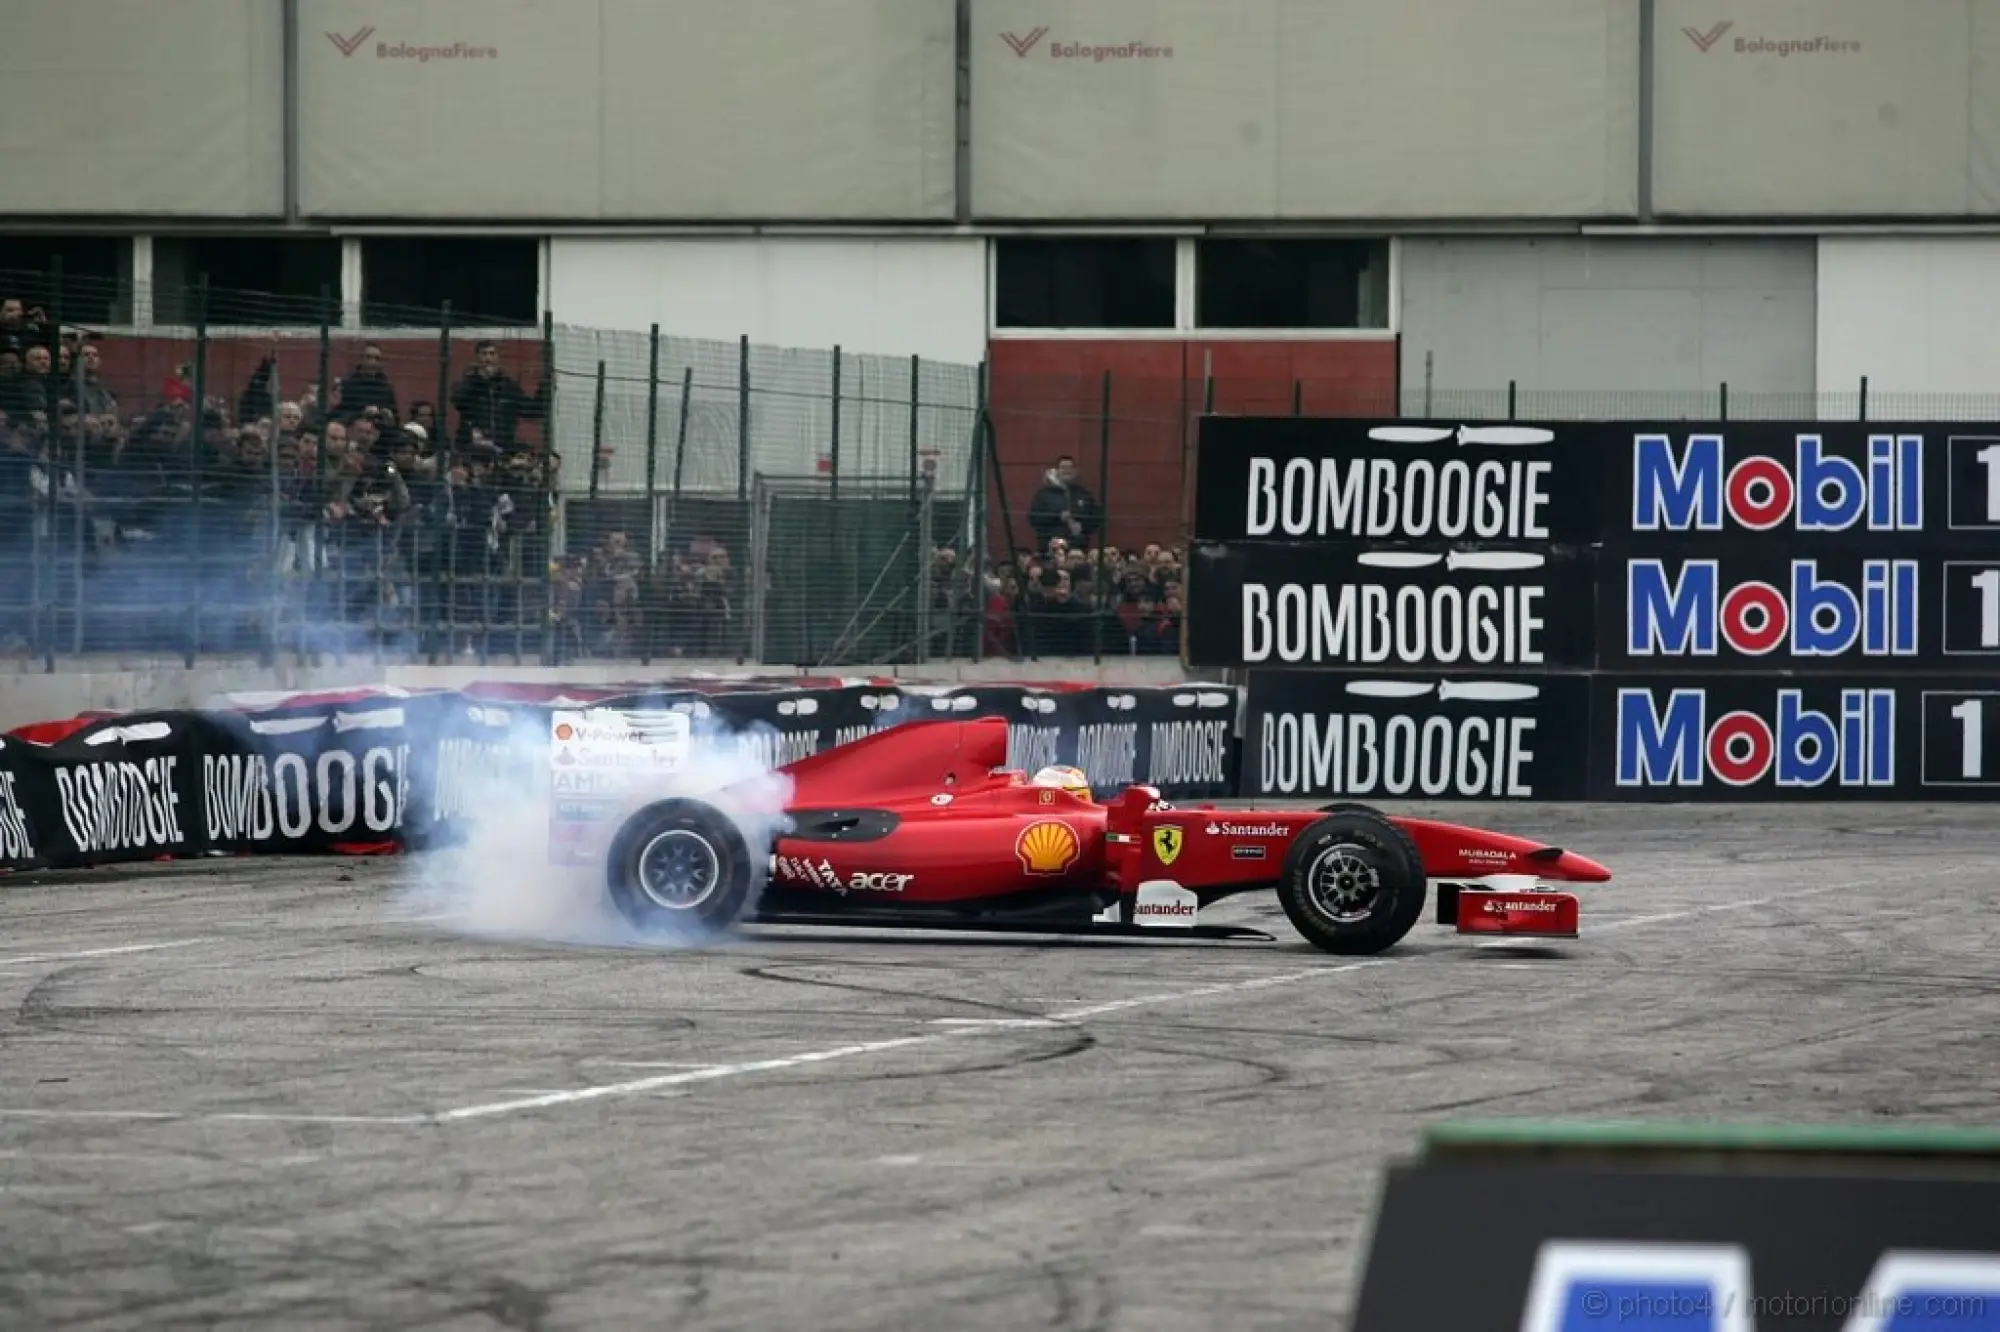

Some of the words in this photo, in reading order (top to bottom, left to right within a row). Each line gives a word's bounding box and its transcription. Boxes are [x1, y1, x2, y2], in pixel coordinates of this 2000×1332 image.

[376, 41, 498, 63] BolognaFiere
[1050, 41, 1174, 63] BolognaFiere
[1734, 36, 1862, 58] BolognaFiere
[1247, 457, 1552, 538] BOMBOOGIE
[1632, 433, 1924, 532] Mobil
[1976, 445, 2000, 522] 1
[1241, 582, 1546, 663] BOMBOOGIE
[1626, 558, 1919, 656] Mobil
[1971, 570, 2000, 648] 1
[1261, 712, 1537, 796] BOMBOOGIE
[1615, 688, 1895, 787] Mobil
[1952, 700, 1983, 778] 1
[1221, 821, 1290, 837] Santander
[1459, 849, 1517, 860] MUBADALA
[849, 872, 916, 892] acer
